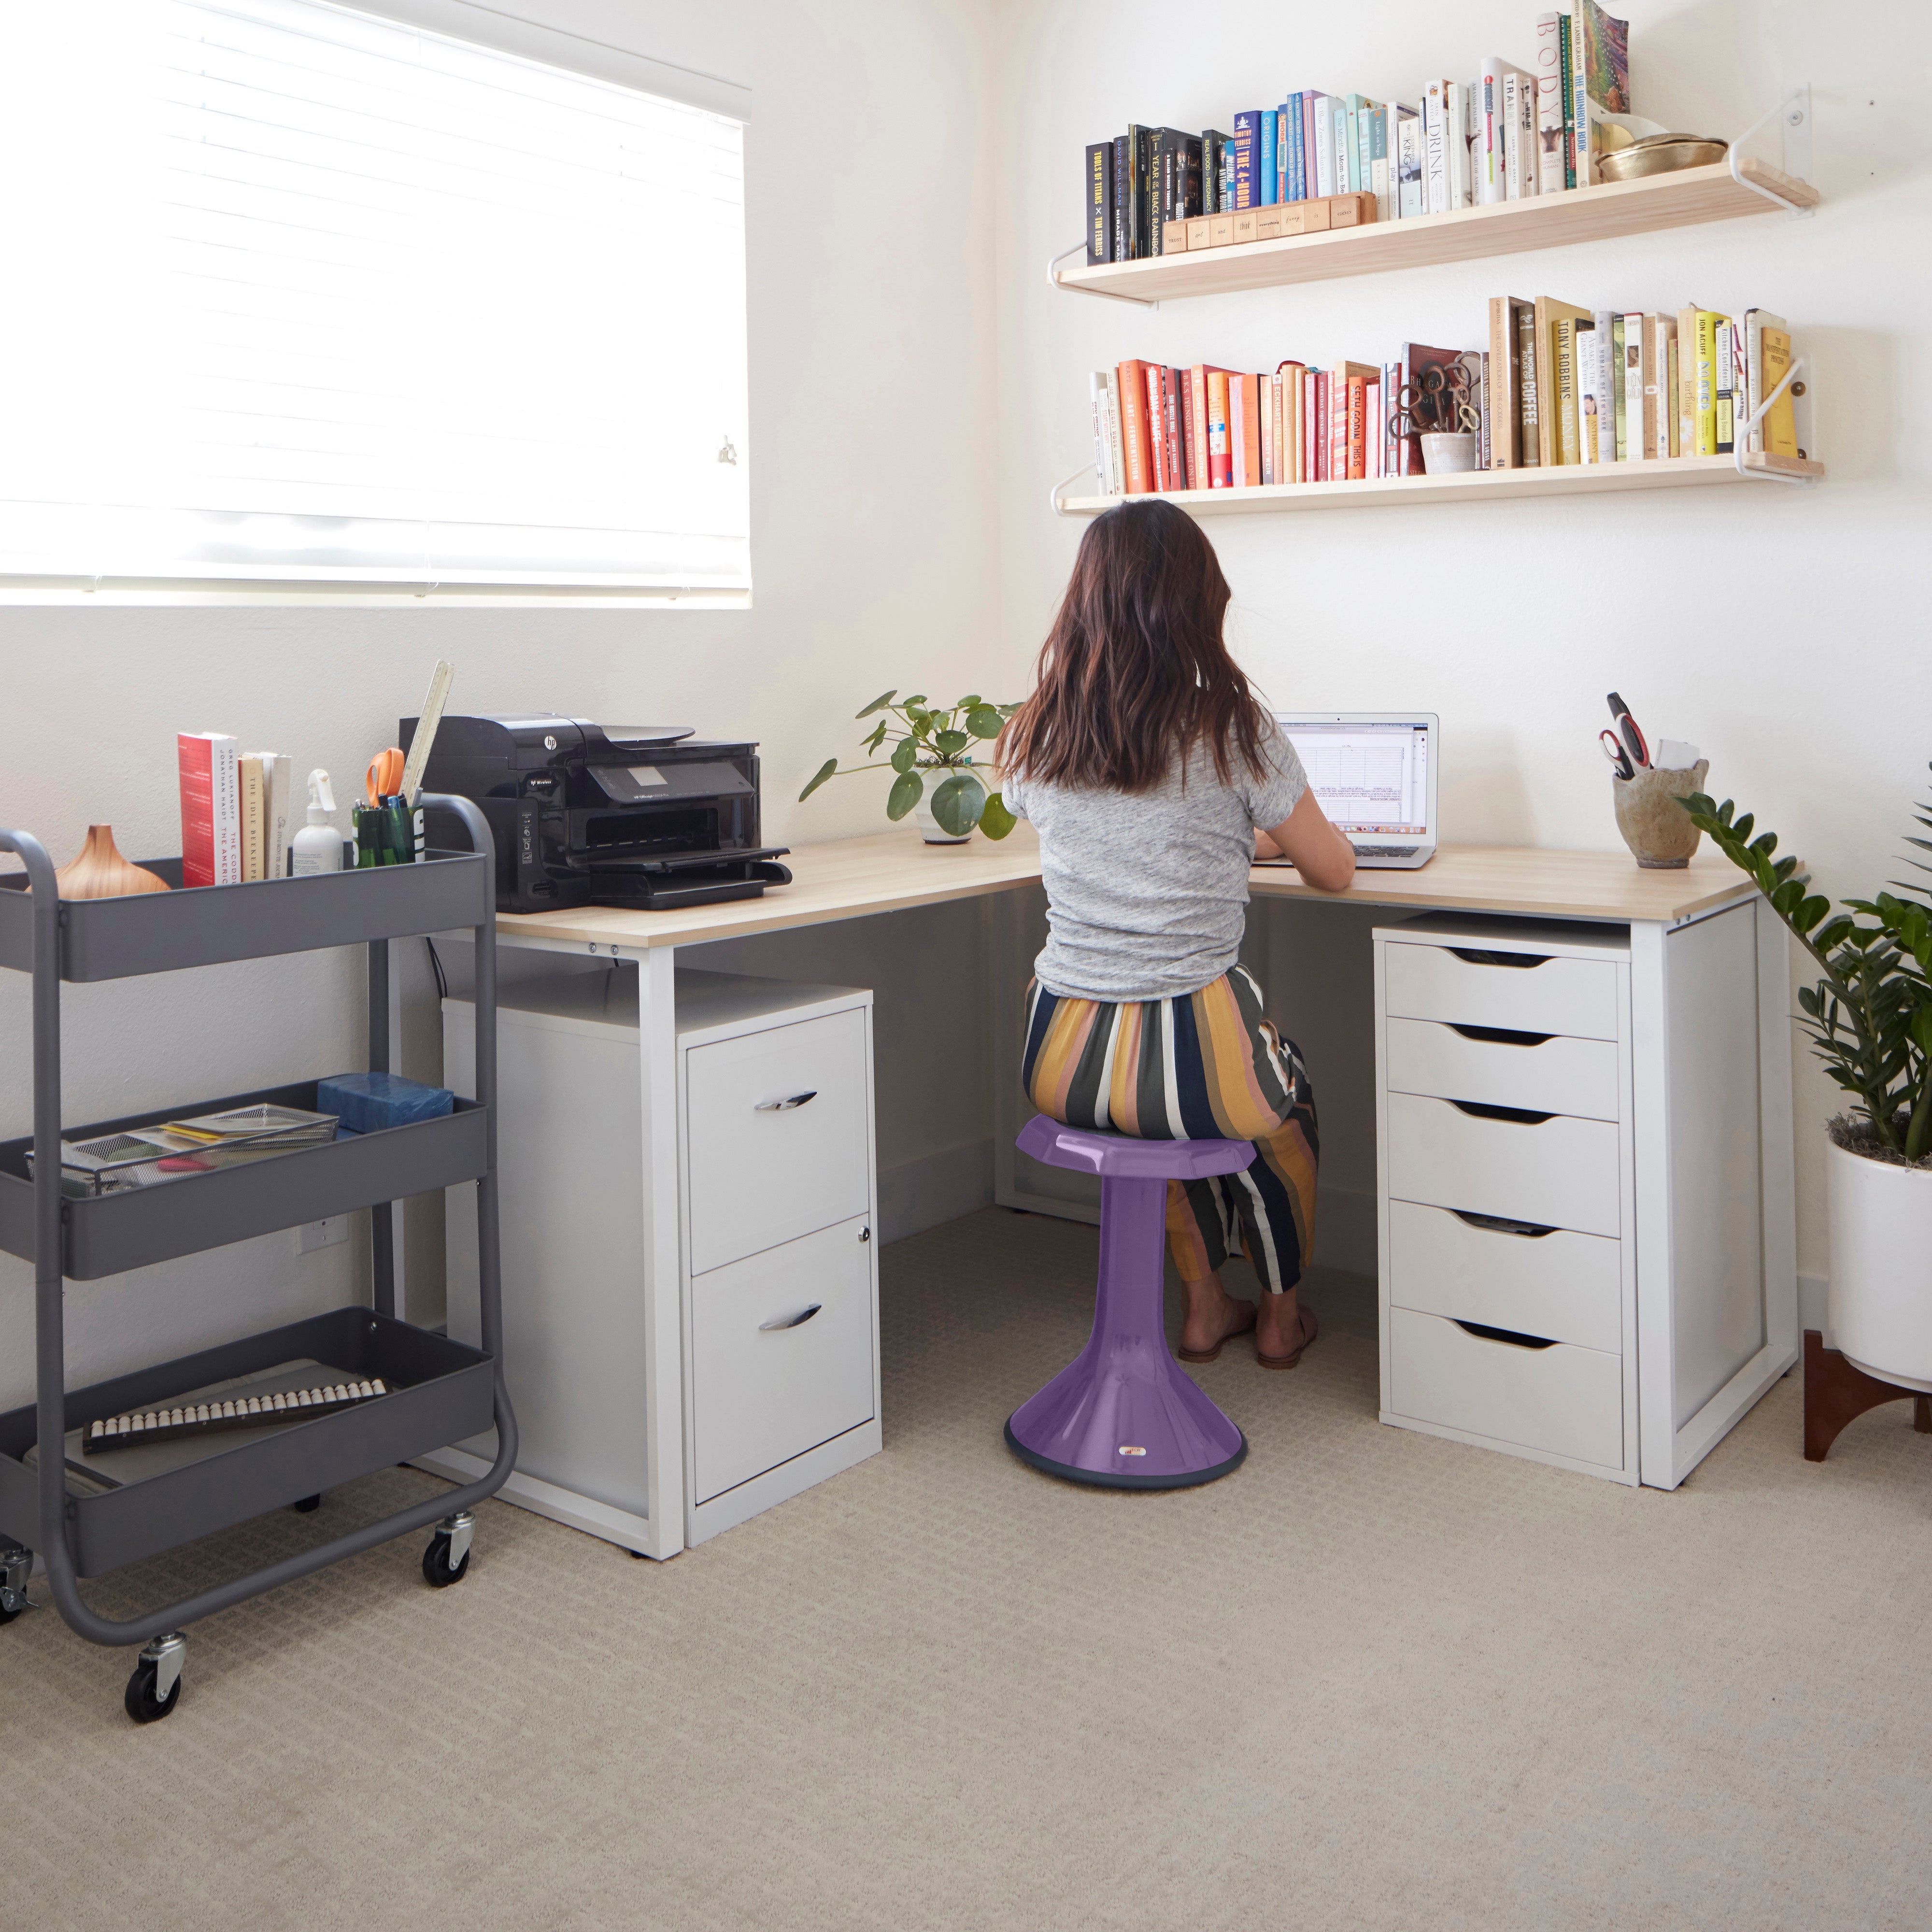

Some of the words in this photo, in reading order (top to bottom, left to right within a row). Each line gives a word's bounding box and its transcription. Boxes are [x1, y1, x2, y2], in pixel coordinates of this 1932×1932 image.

[1537, 21, 1559, 117] BODY
[1575, 73, 1585, 88] THE
[1506, 79, 1515, 127] TRANNY
[1575, 90, 1586, 129] RAINBOW
[1235, 129, 1251, 139] TIMOTHY
[1235, 139, 1251, 147] FERRISS
[1577, 131, 1587, 153] BOOK
[1094, 151, 1102, 171] TOOLS
[1237, 150, 1250, 169] THE
[1403, 139, 1411, 165] KING
[1429, 124, 1442, 181] DRINK
[1226, 156, 1235, 184] INFLUENCE
[1219, 169, 1227, 193] ANTHONY
[1237, 172, 1250, 209] 4-HOUR
[1239, 221, 1250, 230] think
[1285, 215, 1300, 224] funny
[1557, 322, 1569, 349] TONY
[1522, 371, 1528, 380] OF
[1559, 353, 1571, 400] ROBBINS
[1696, 362, 1710, 377] DO
[1497, 382, 1503, 390] OF
[1600, 382, 1605, 390] OF
[1696, 380, 1710, 411] OVER
[1151, 396, 1159, 411] DAY
[1350, 385, 1361, 408] SETH
[1522, 381, 1538, 426] COFFEE
[1127, 404, 1135, 418] ART
[1196, 412, 1202, 421] OF
[1152, 427, 1161, 442] LIFE
[1350, 410, 1360, 440] GODIN
[1563, 405, 1574, 451] MONEY
[1128, 425, 1139, 481] FERMENTATION
[1188, 465, 1194, 476] ON
[547, 736, 555, 751] hp
[278, 816, 286, 830] The
